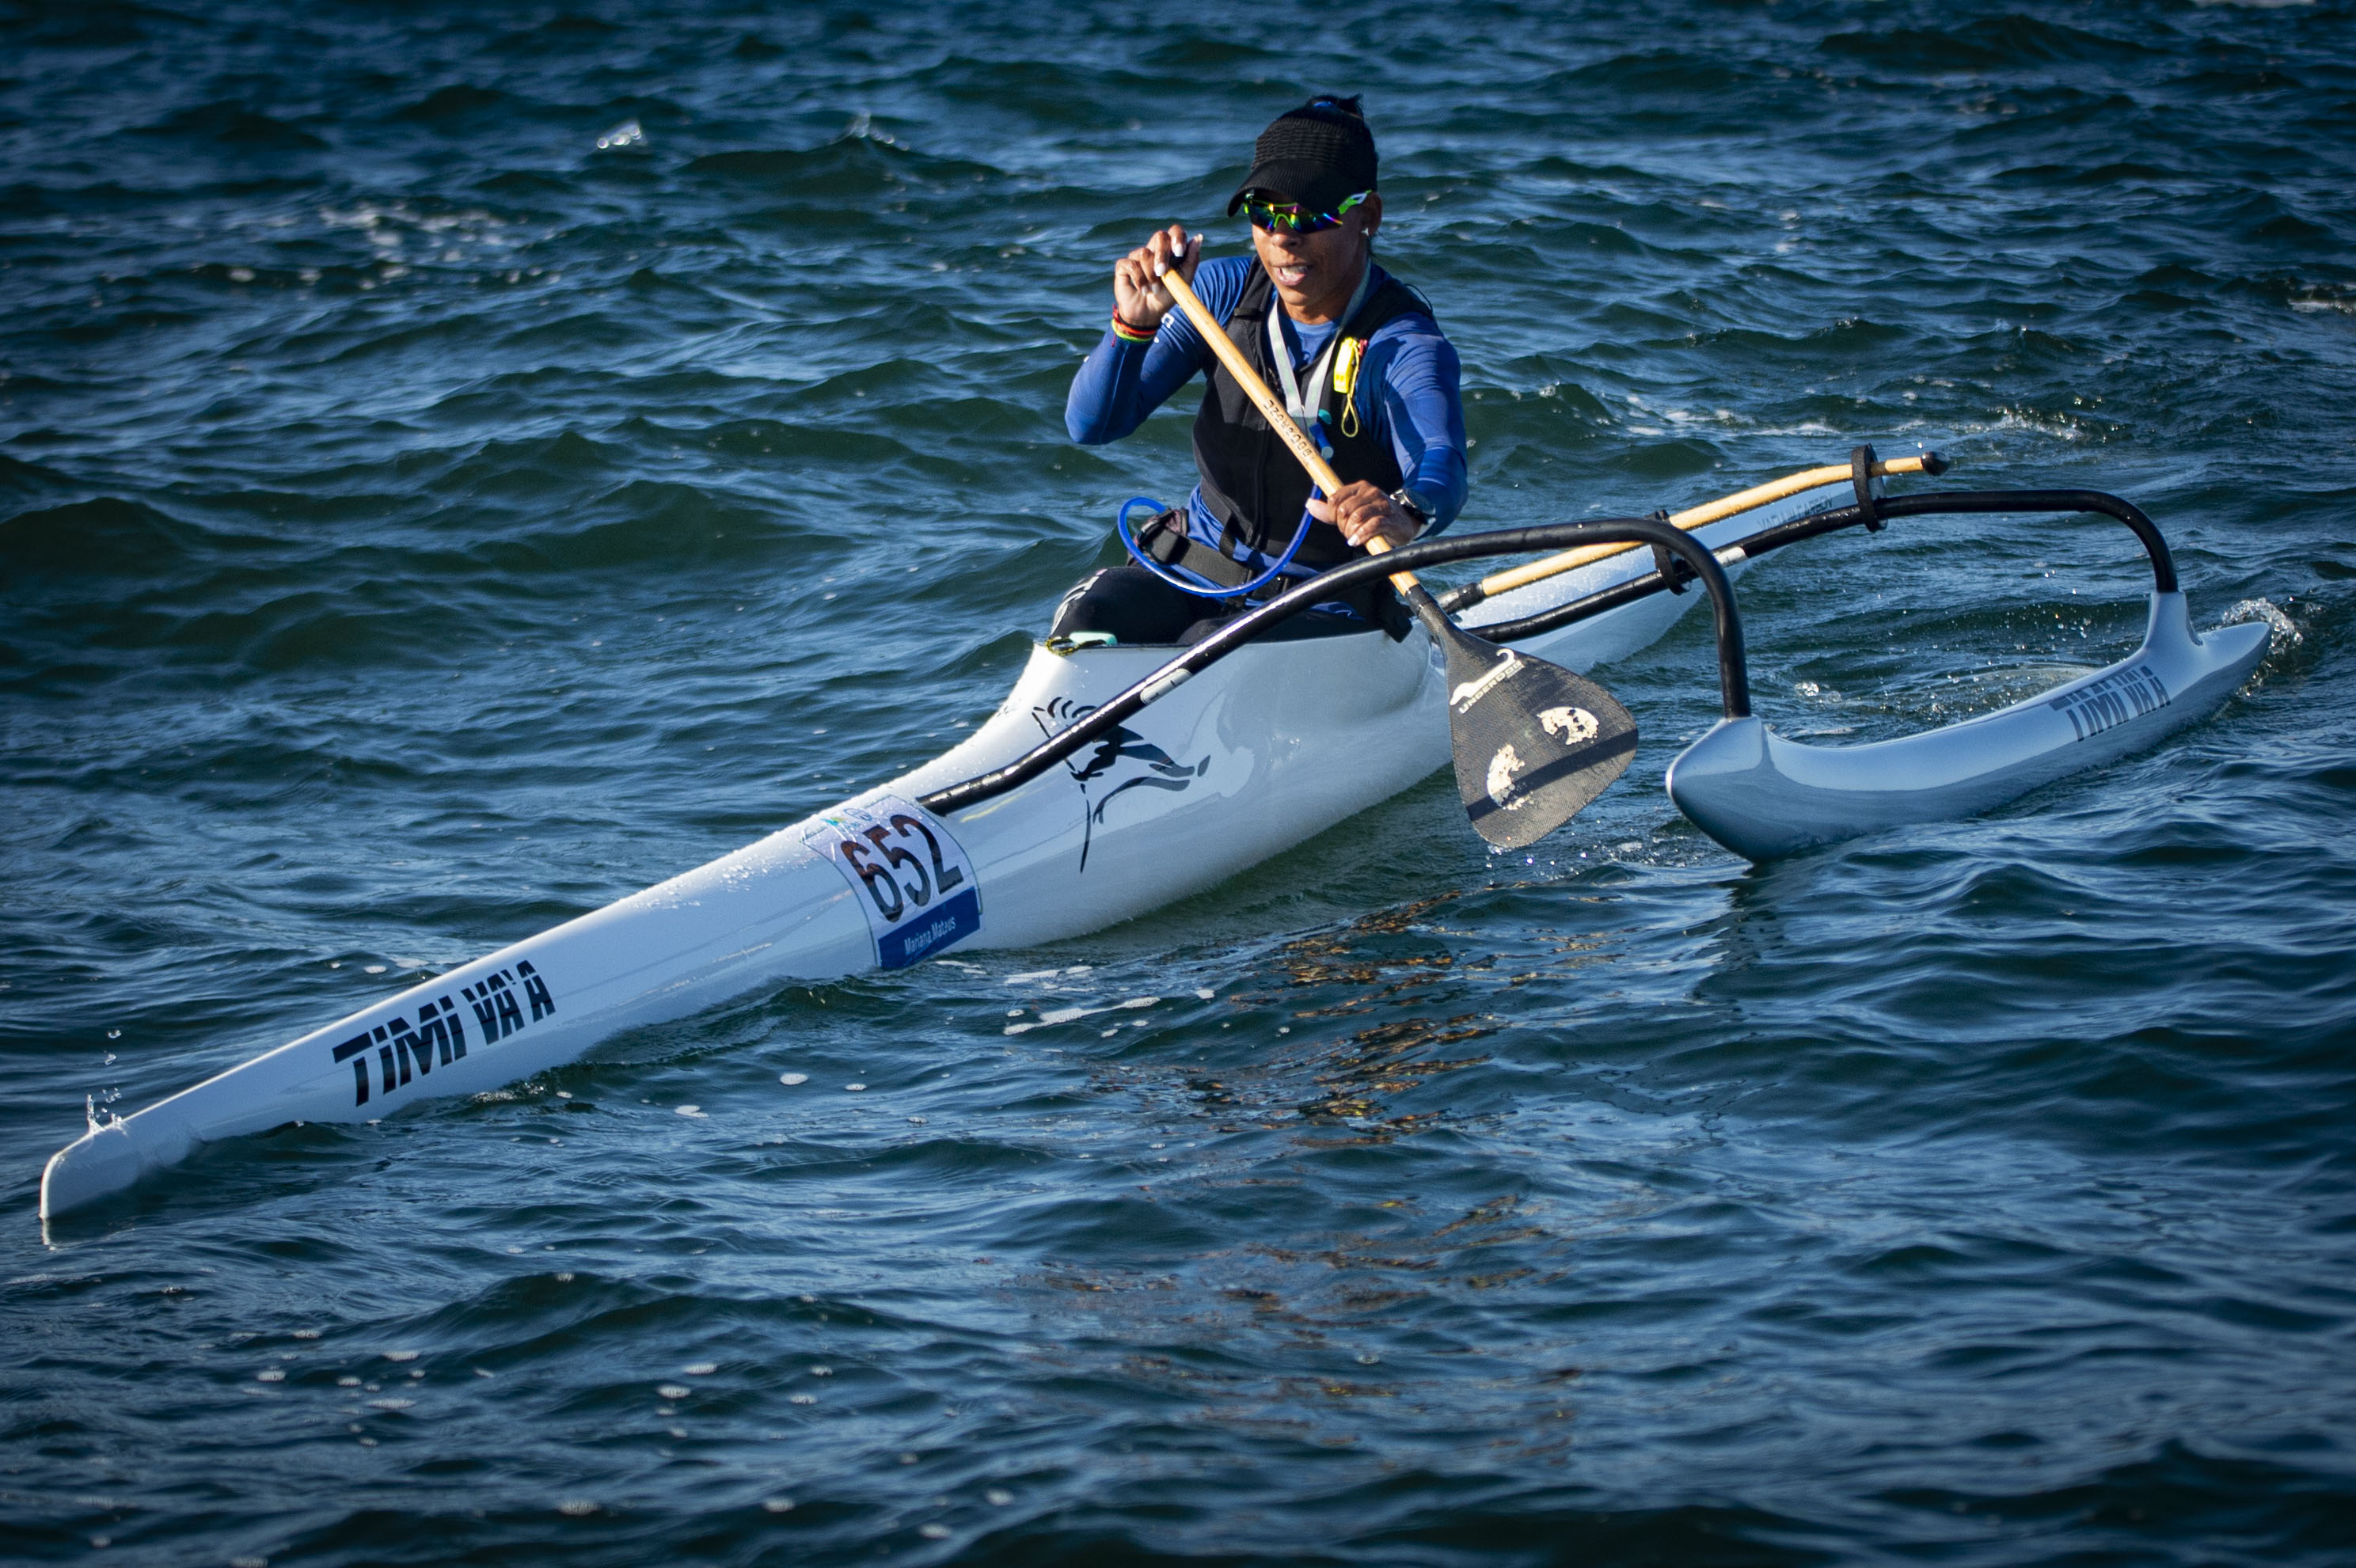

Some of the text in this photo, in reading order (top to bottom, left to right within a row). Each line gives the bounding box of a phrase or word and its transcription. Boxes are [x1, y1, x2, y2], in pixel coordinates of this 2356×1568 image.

[1458, 659, 1523, 714] UNDERDOG
[2048, 679, 2130, 742] TIMI
[840, 814, 964, 923] 652
[904, 930, 933, 957] Mariana
[332, 995, 467, 1107] TIMI
